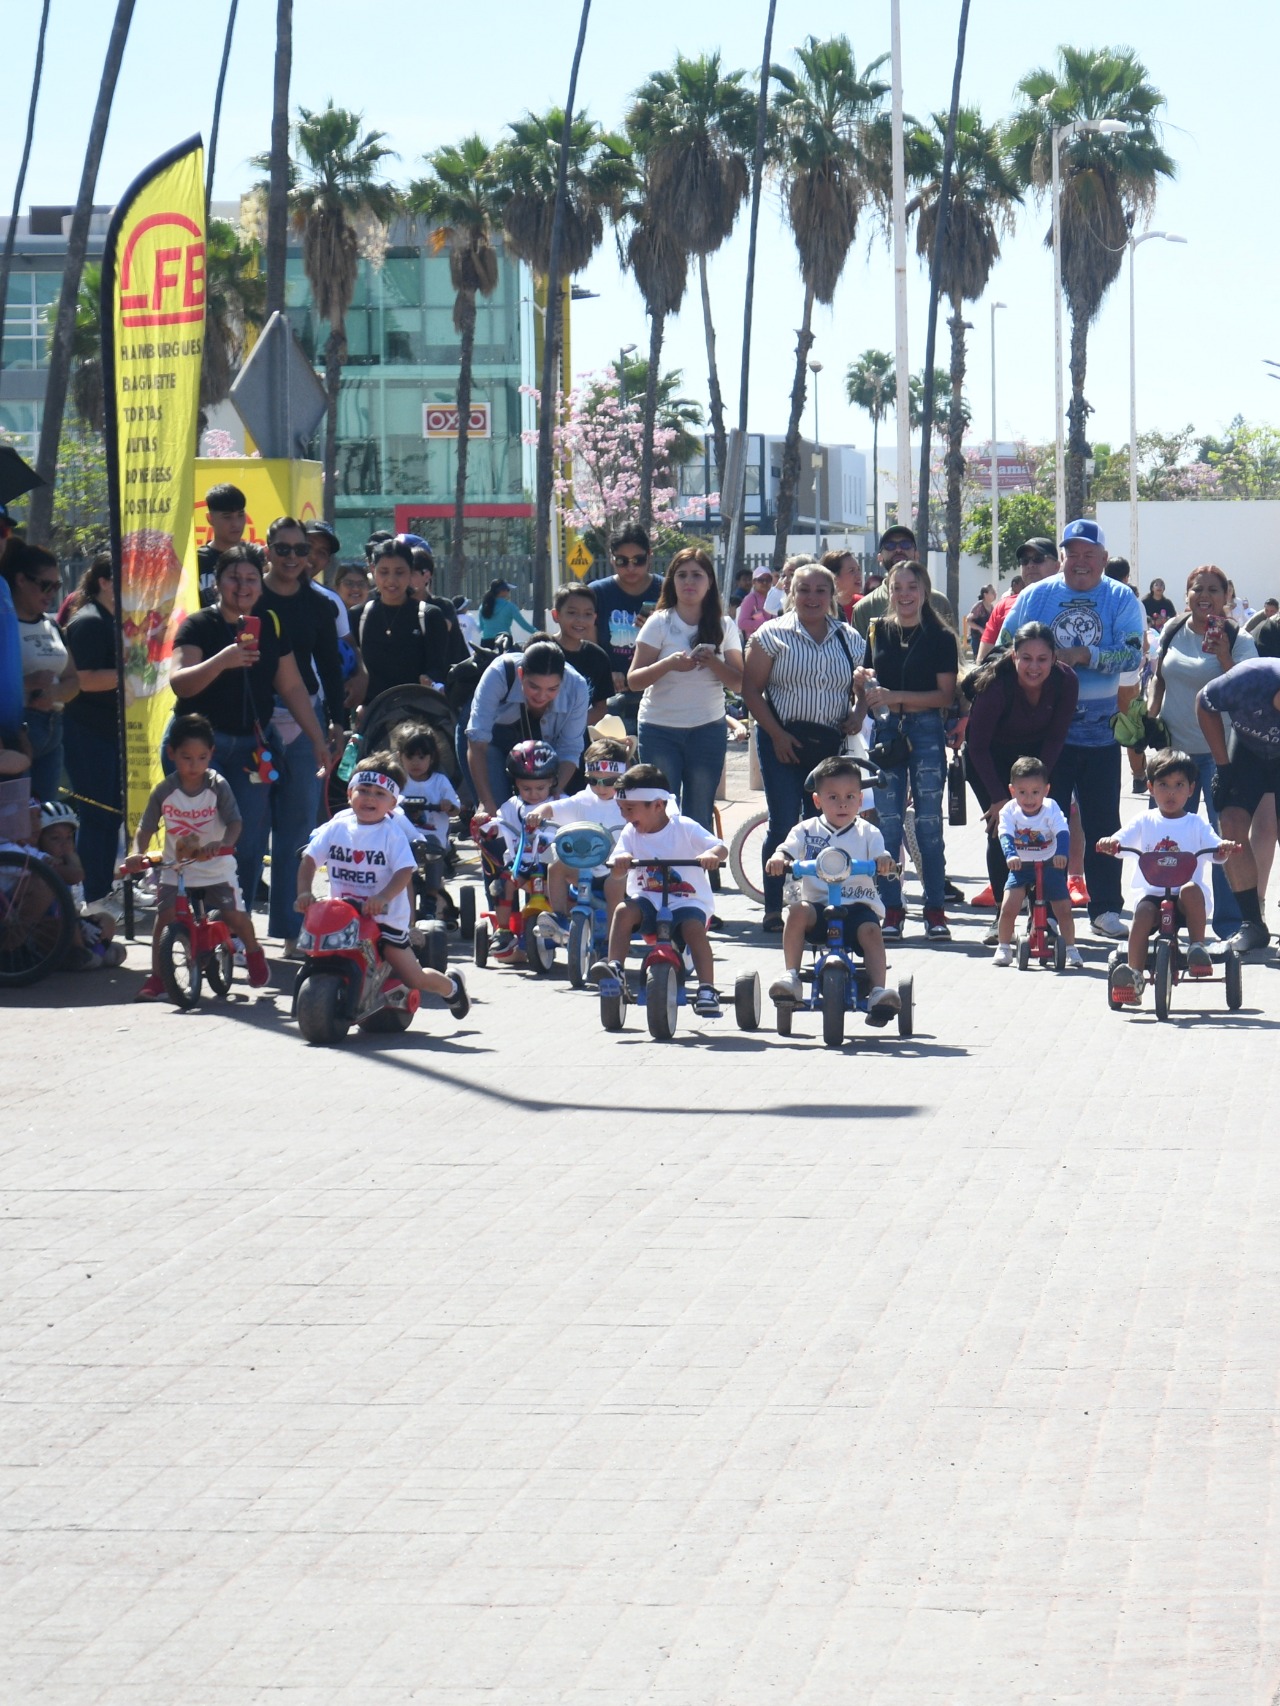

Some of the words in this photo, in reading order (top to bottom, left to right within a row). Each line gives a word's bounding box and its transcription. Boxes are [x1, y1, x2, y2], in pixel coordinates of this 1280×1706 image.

[124, 405, 163, 422] TORTAS
[429, 412, 485, 432] OXO
[163, 804, 216, 819] Reebok
[331, 867, 378, 883] URREA
